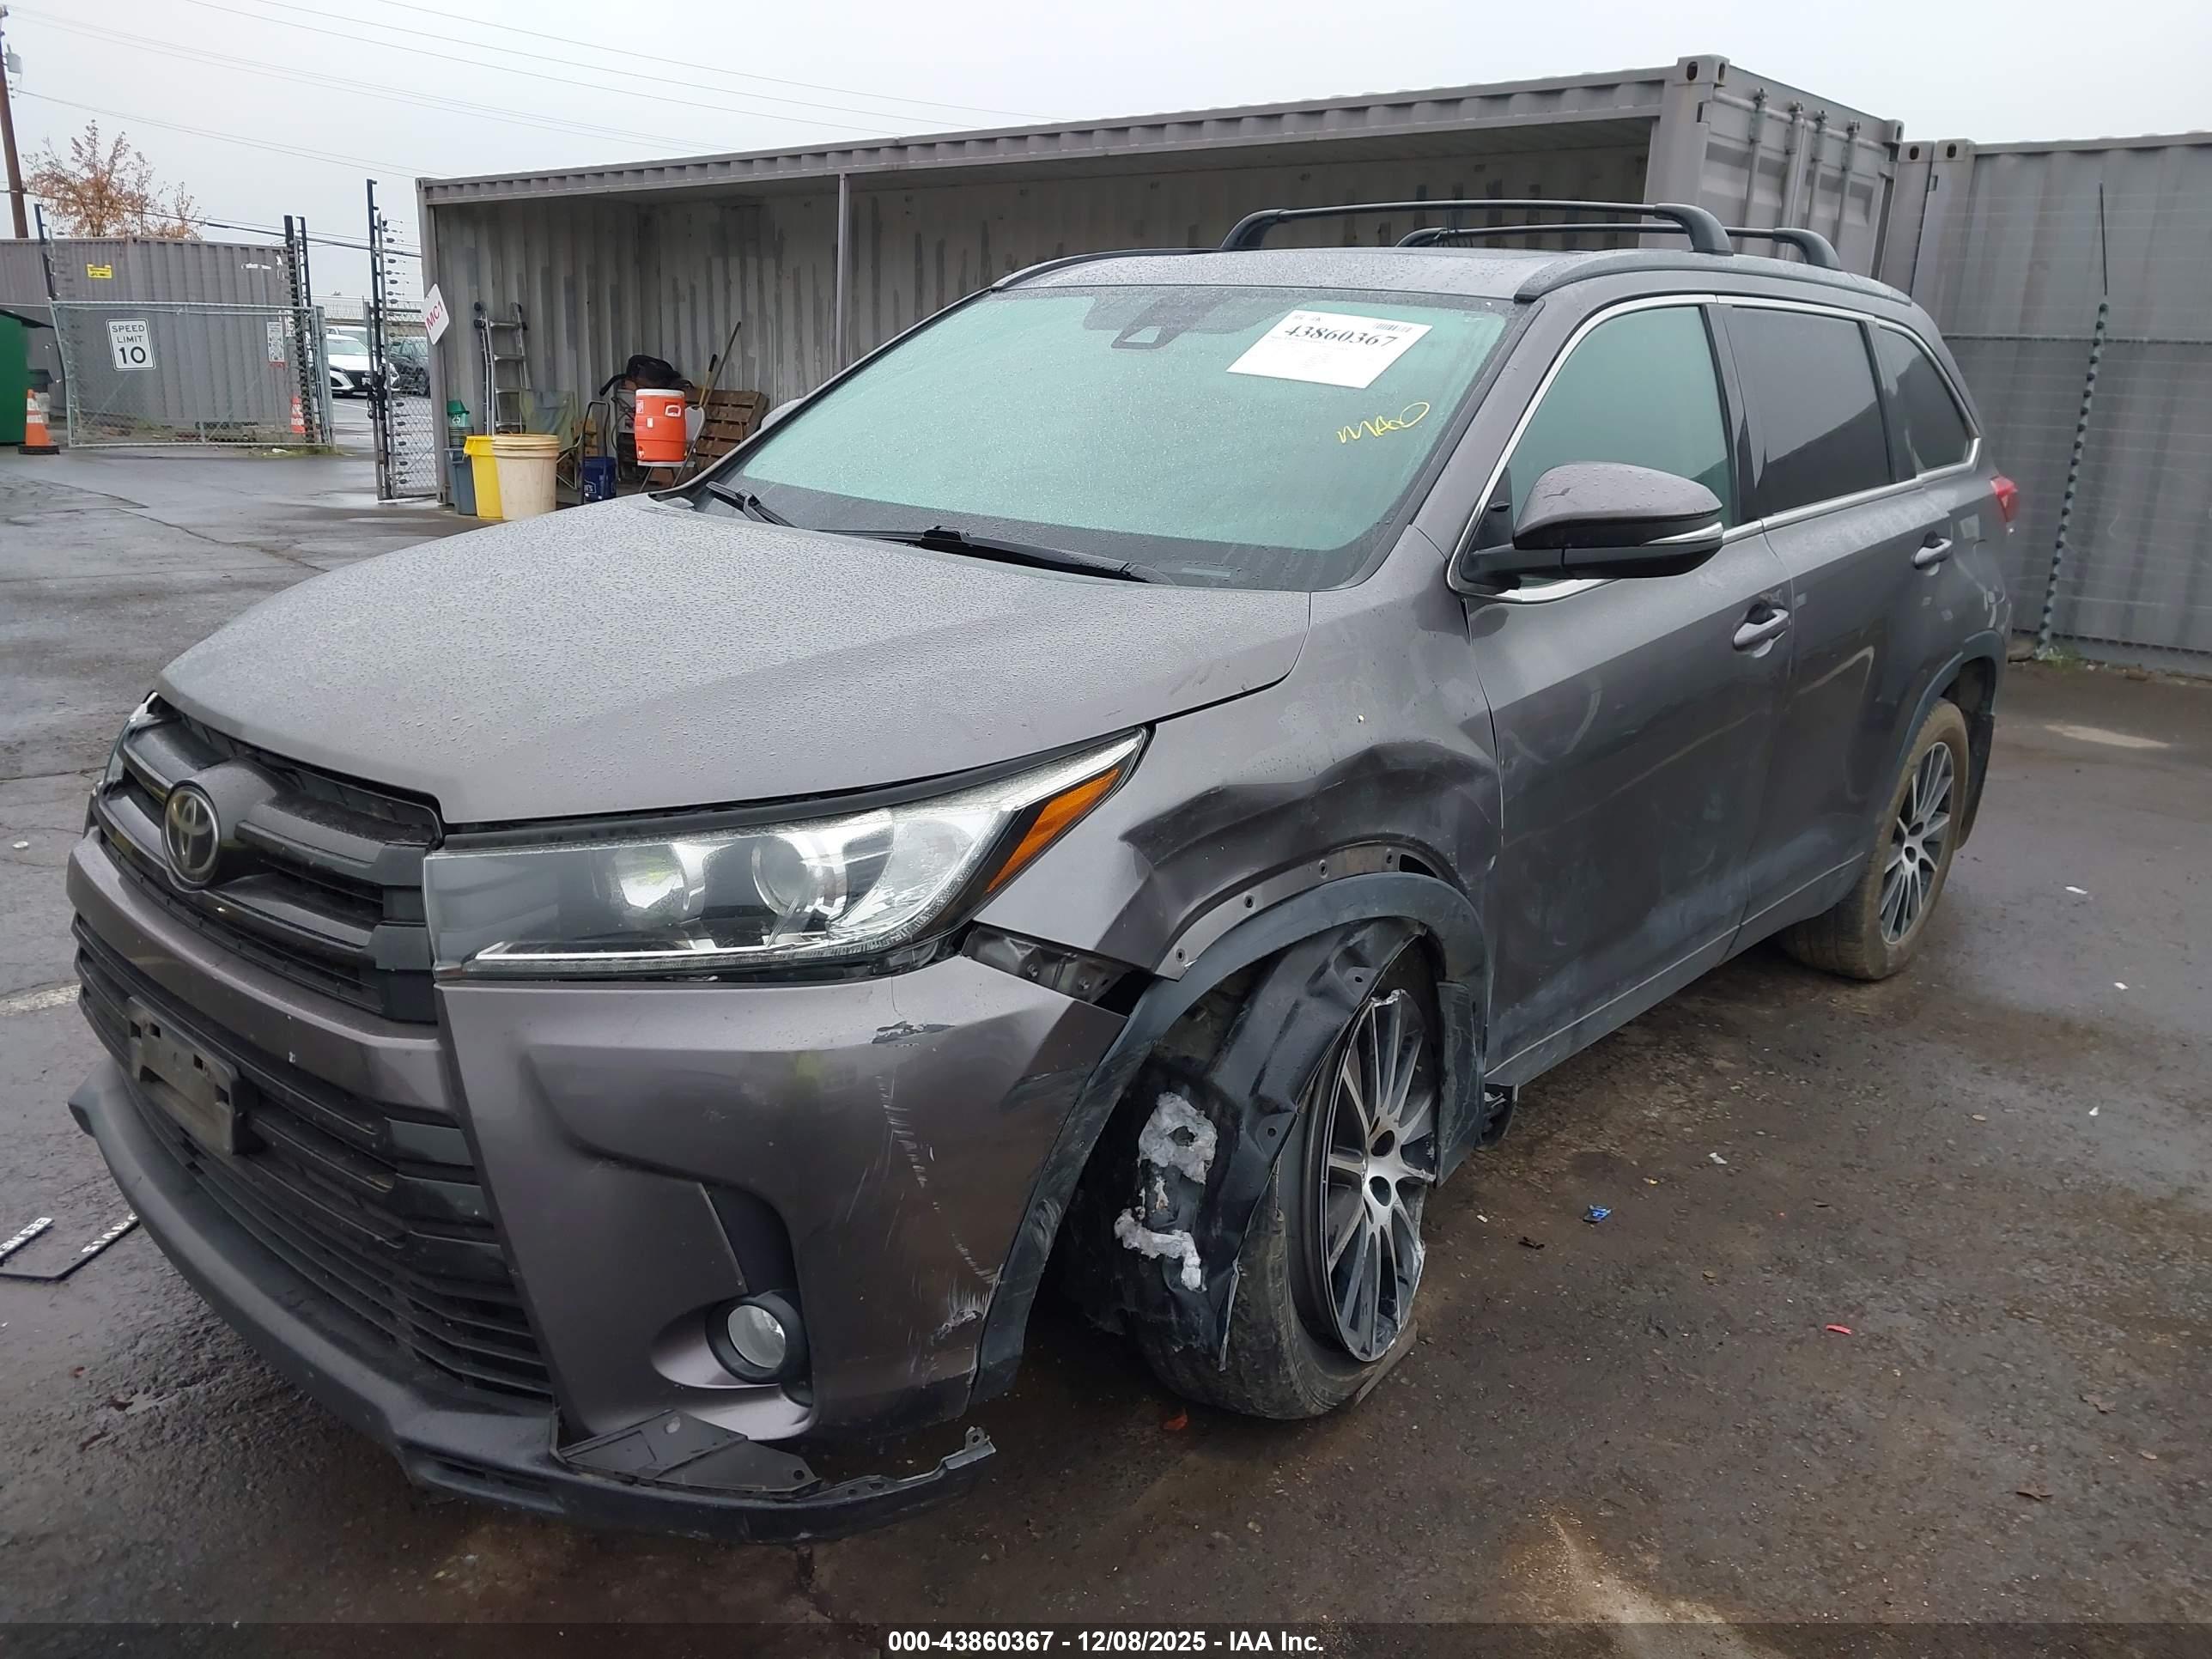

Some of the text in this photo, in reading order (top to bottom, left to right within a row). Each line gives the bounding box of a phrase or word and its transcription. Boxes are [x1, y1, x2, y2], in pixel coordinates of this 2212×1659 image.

[426, 301, 443, 331] MC1
[117, 335, 143, 343] LIMIT
[1285, 324, 1399, 348] 43860367
[118, 346, 146, 364] 10
